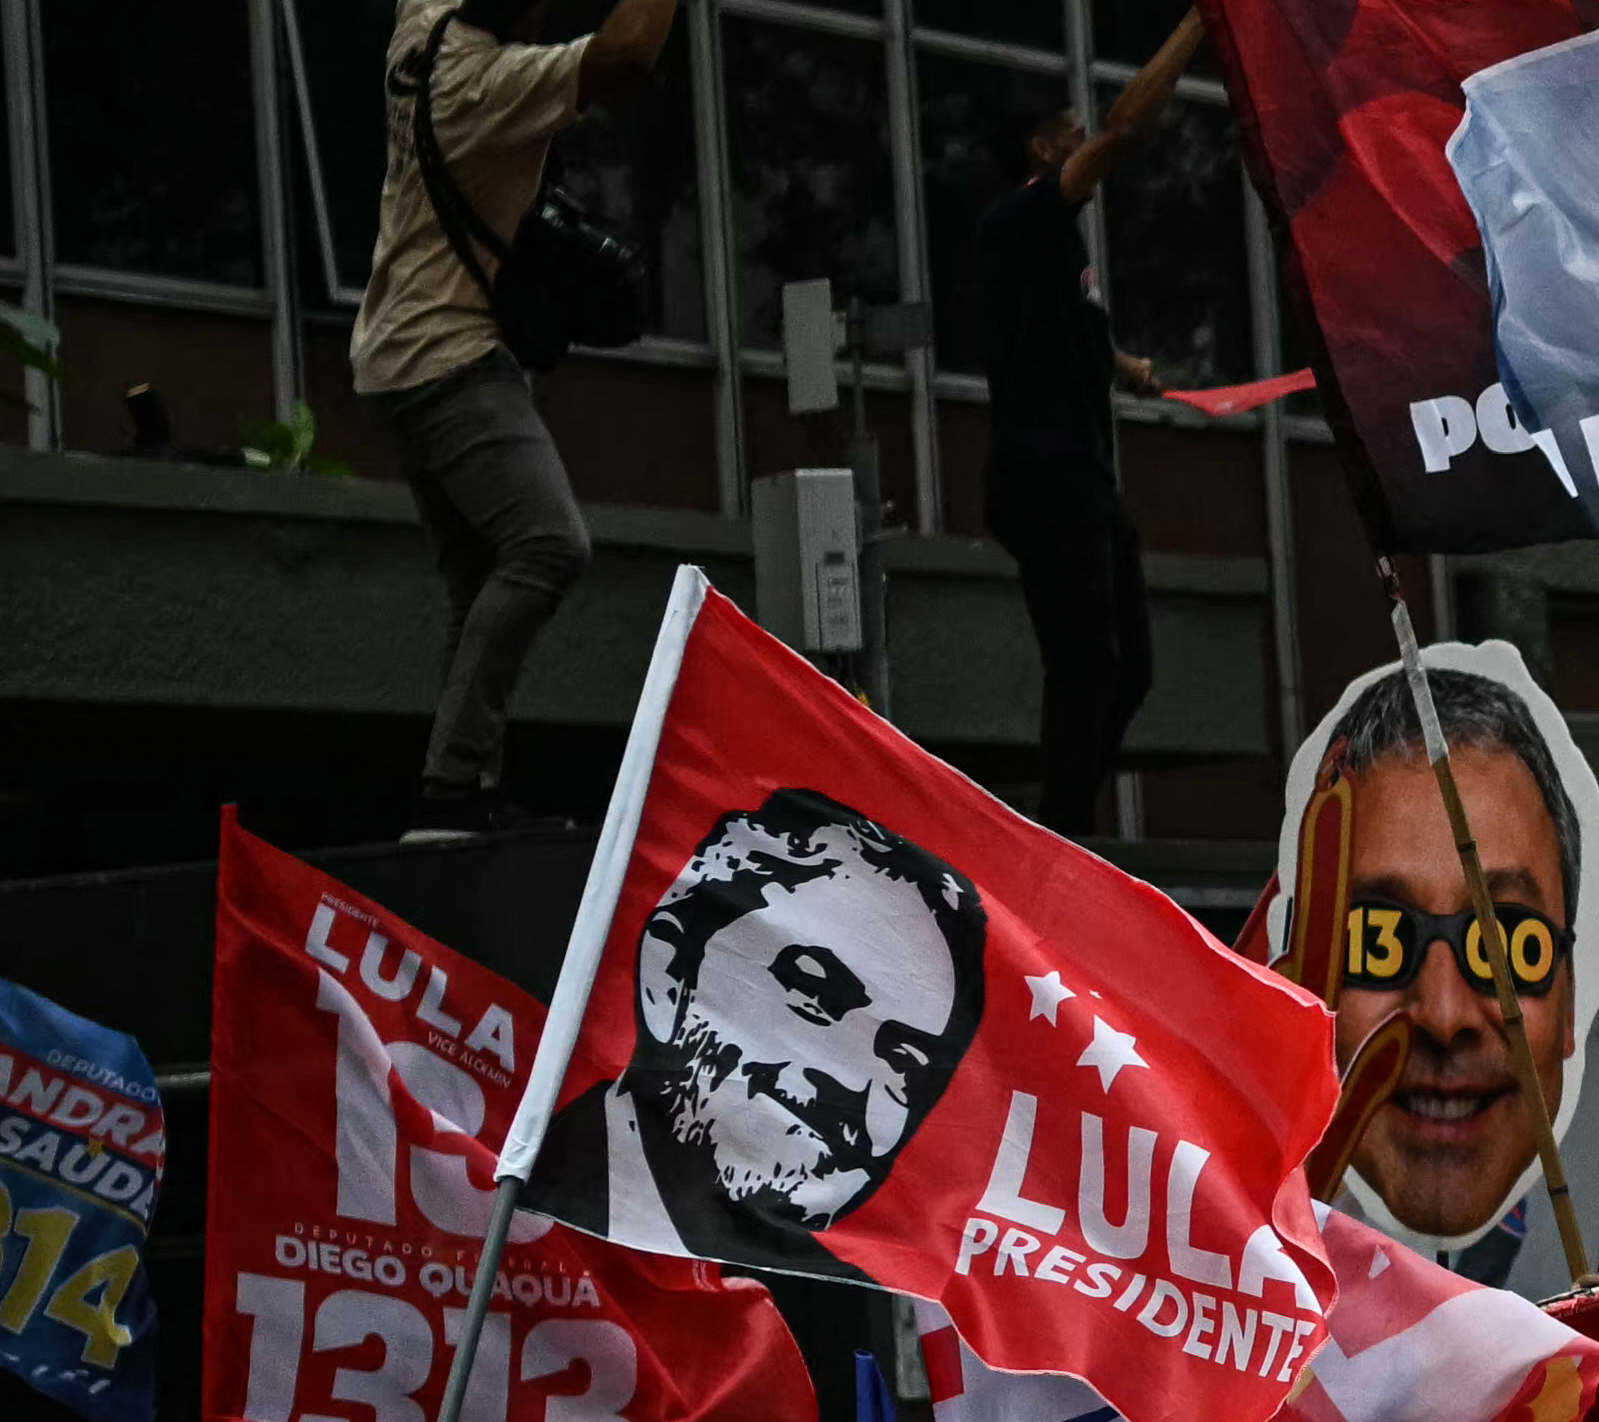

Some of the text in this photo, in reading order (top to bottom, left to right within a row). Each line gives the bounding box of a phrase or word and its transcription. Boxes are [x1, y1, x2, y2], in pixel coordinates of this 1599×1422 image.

[304, 901, 516, 1074] LULA
[46, 1047, 162, 1101] DEPUTADO
[426, 1030, 459, 1058] VICE
[314, 966, 556, 1247] 13
[274, 1233, 407, 1287] DIEGO
[294, 1221, 433, 1259] DEPUTADO
[977, 1090, 1326, 1318] LULA
[954, 1214, 1319, 1385] PRESIDENTE
